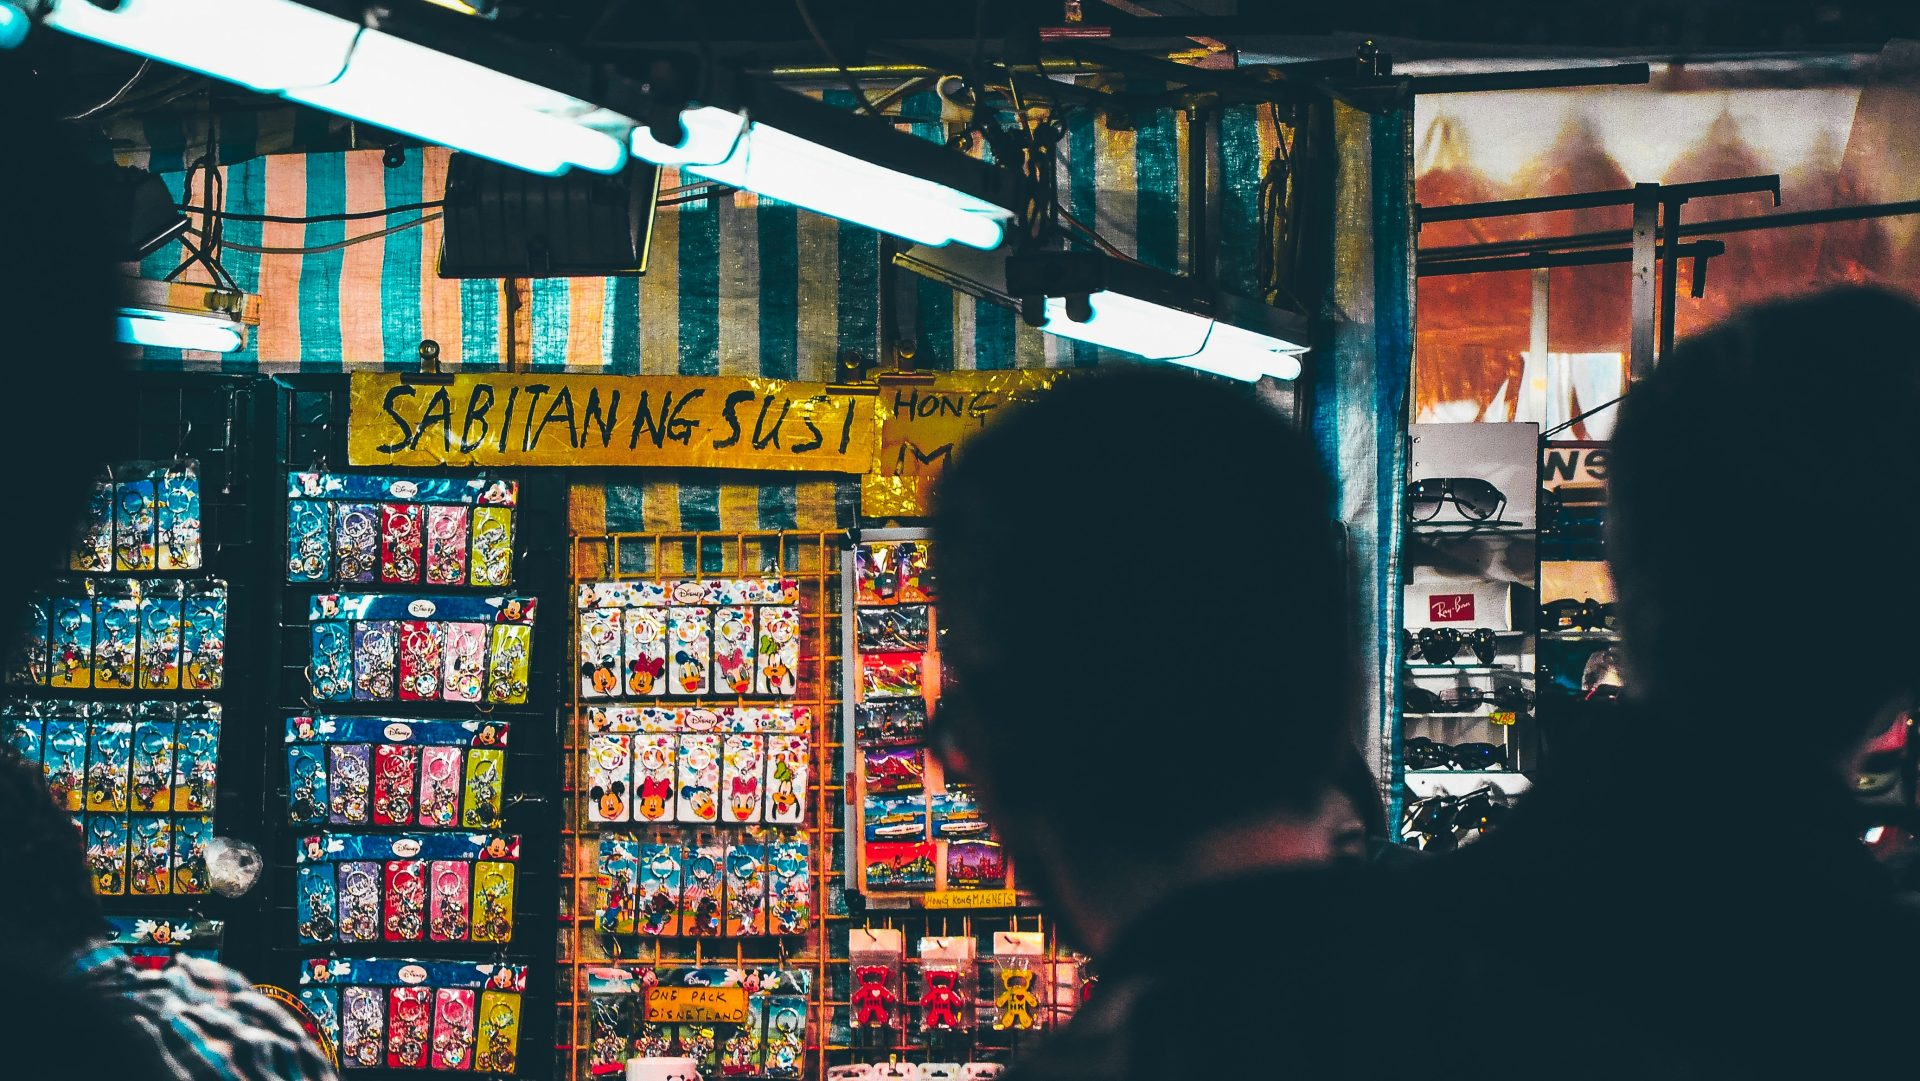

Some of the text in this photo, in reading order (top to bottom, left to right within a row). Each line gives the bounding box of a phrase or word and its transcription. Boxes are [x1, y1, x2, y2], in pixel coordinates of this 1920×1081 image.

[395, 484, 416, 495] Disney
[679, 588, 703, 602] Disney
[413, 604, 434, 614] Disney
[691, 715, 716, 728] Disney
[389, 727, 410, 738] Disney
[398, 843, 419, 854] Disney
[649, 989, 727, 1003] ONE PACK
